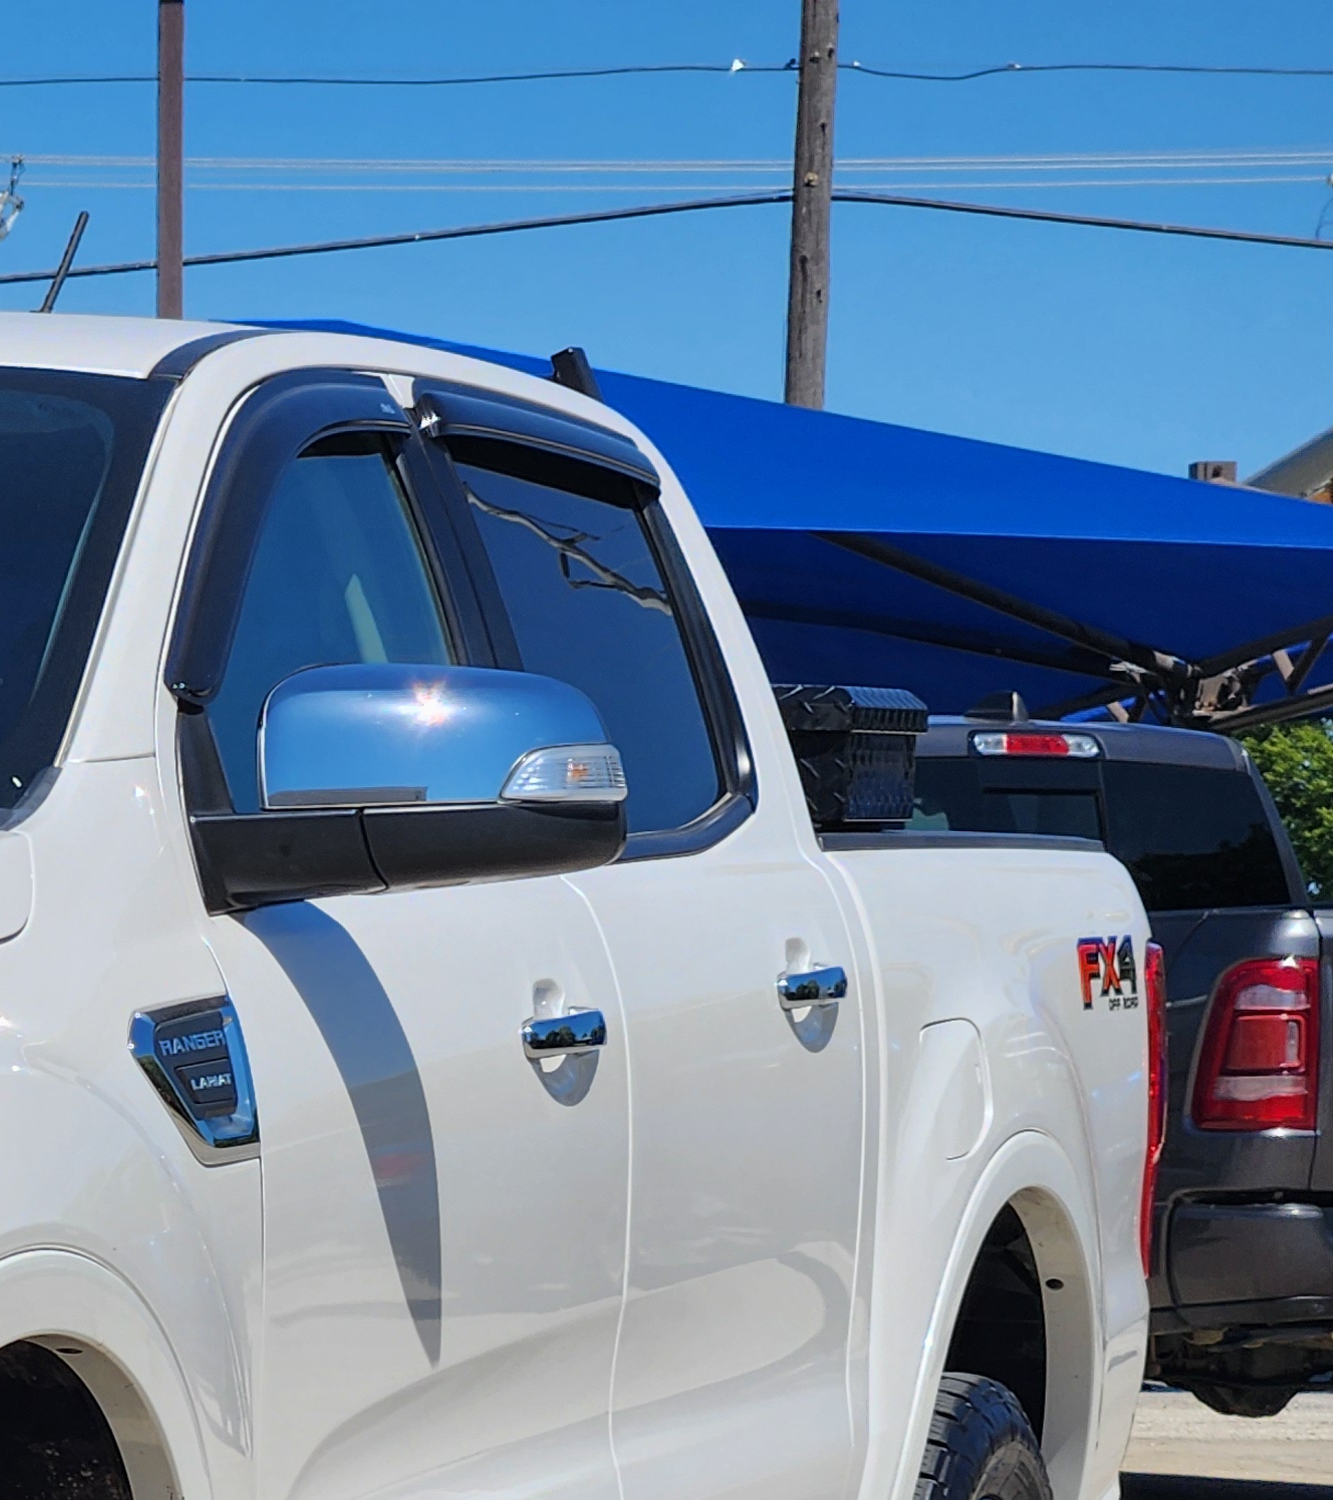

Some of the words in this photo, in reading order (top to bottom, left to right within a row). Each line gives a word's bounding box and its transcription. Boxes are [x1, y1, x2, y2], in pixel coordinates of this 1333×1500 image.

[1076, 934, 1137, 1011] FX4
[159, 1029, 226, 1057] RANGER
[190, 1072, 232, 1091] LARIAT
